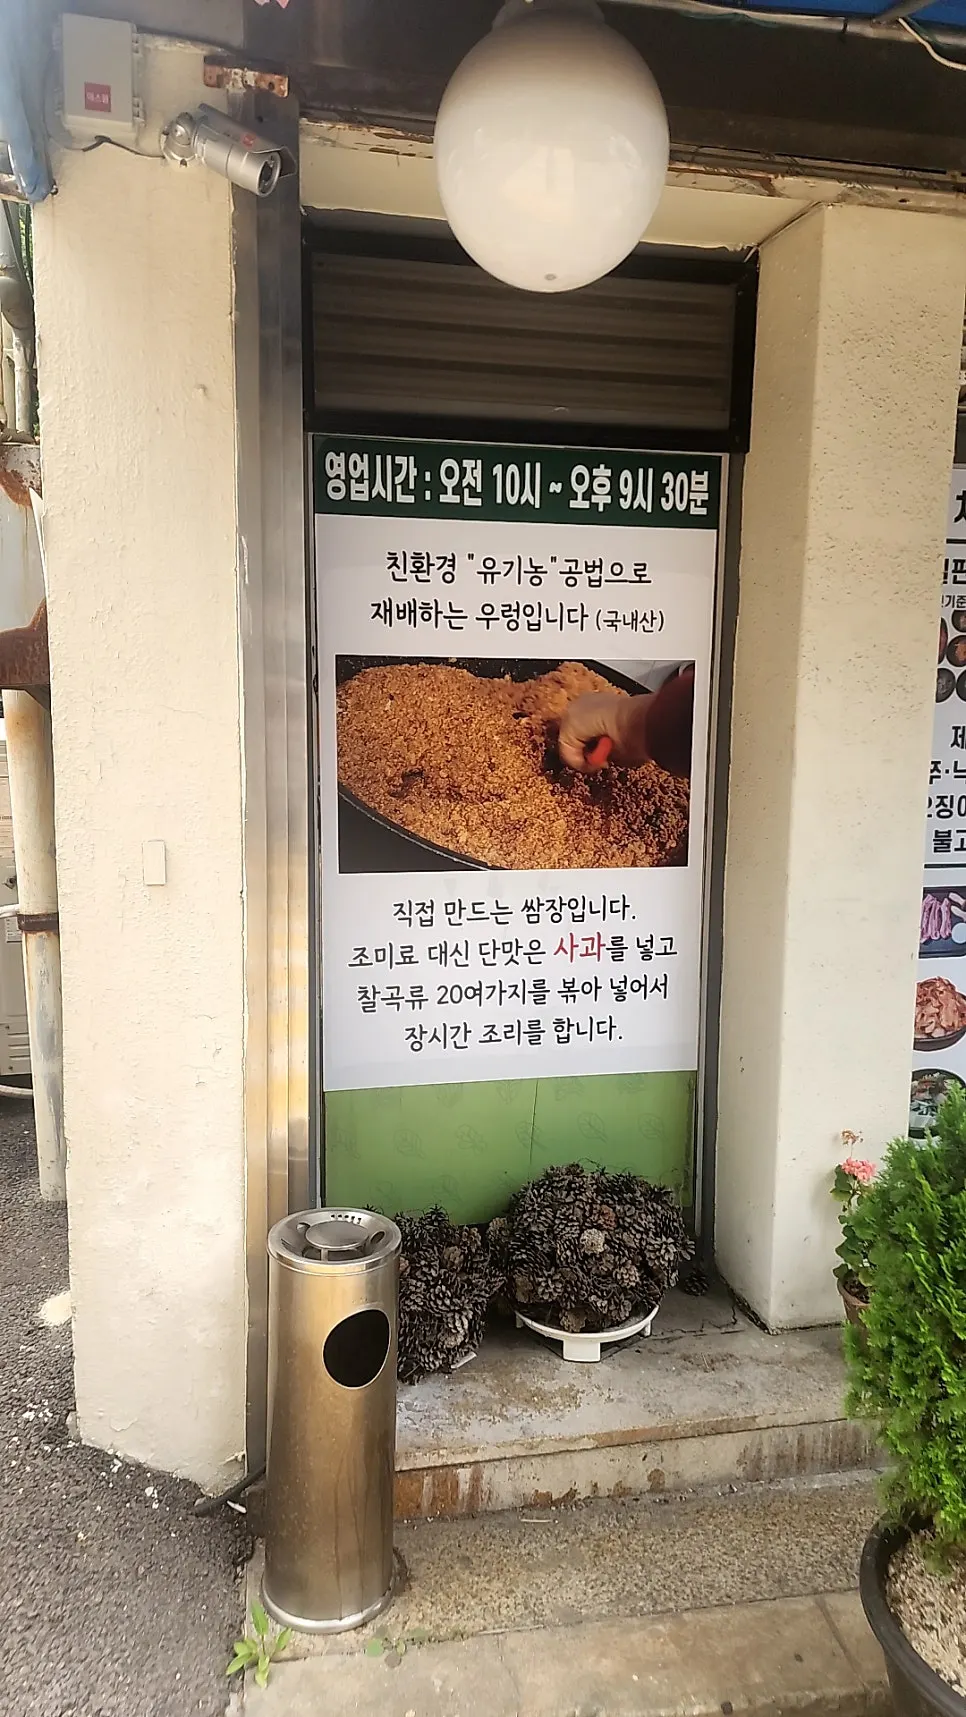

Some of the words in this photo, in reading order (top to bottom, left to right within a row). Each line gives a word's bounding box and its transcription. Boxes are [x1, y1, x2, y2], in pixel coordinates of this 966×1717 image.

[325, 451, 418, 504] 영업시간
[439, 458, 482, 507] 오전
[492, 462, 541, 509] 10시
[569, 463, 612, 512] 오후
[619, 467, 654, 513] 9시
[660, 470, 709, 515] 30분
[386, 550, 456, 585] 친환경
[370, 596, 469, 631] 재배하는
[475, 600, 589, 632] 우렁입니다
[595, 609, 665, 633] (국내산)
[393, 899, 435, 928] 직접
[444, 898, 514, 927] 만드는
[520, 894, 636, 925] 쌈장입니다.
[348, 942, 419, 970] 조미료
[427, 939, 469, 968] 대신
[478, 937, 546, 967] 단맛은
[553, 931, 629, 963] 사과를
[636, 933, 678, 962] 넣고
[357, 984, 429, 1013] 찰곡류
[437, 978, 551, 1007] 20여가지를
[557, 975, 603, 1004] 볶아
[609, 973, 668, 1003] 넣어서
[405, 1021, 472, 1052] 장시간
[478, 1019, 546, 1046] 조리를
[552, 1015, 623, 1045] 합니다.
